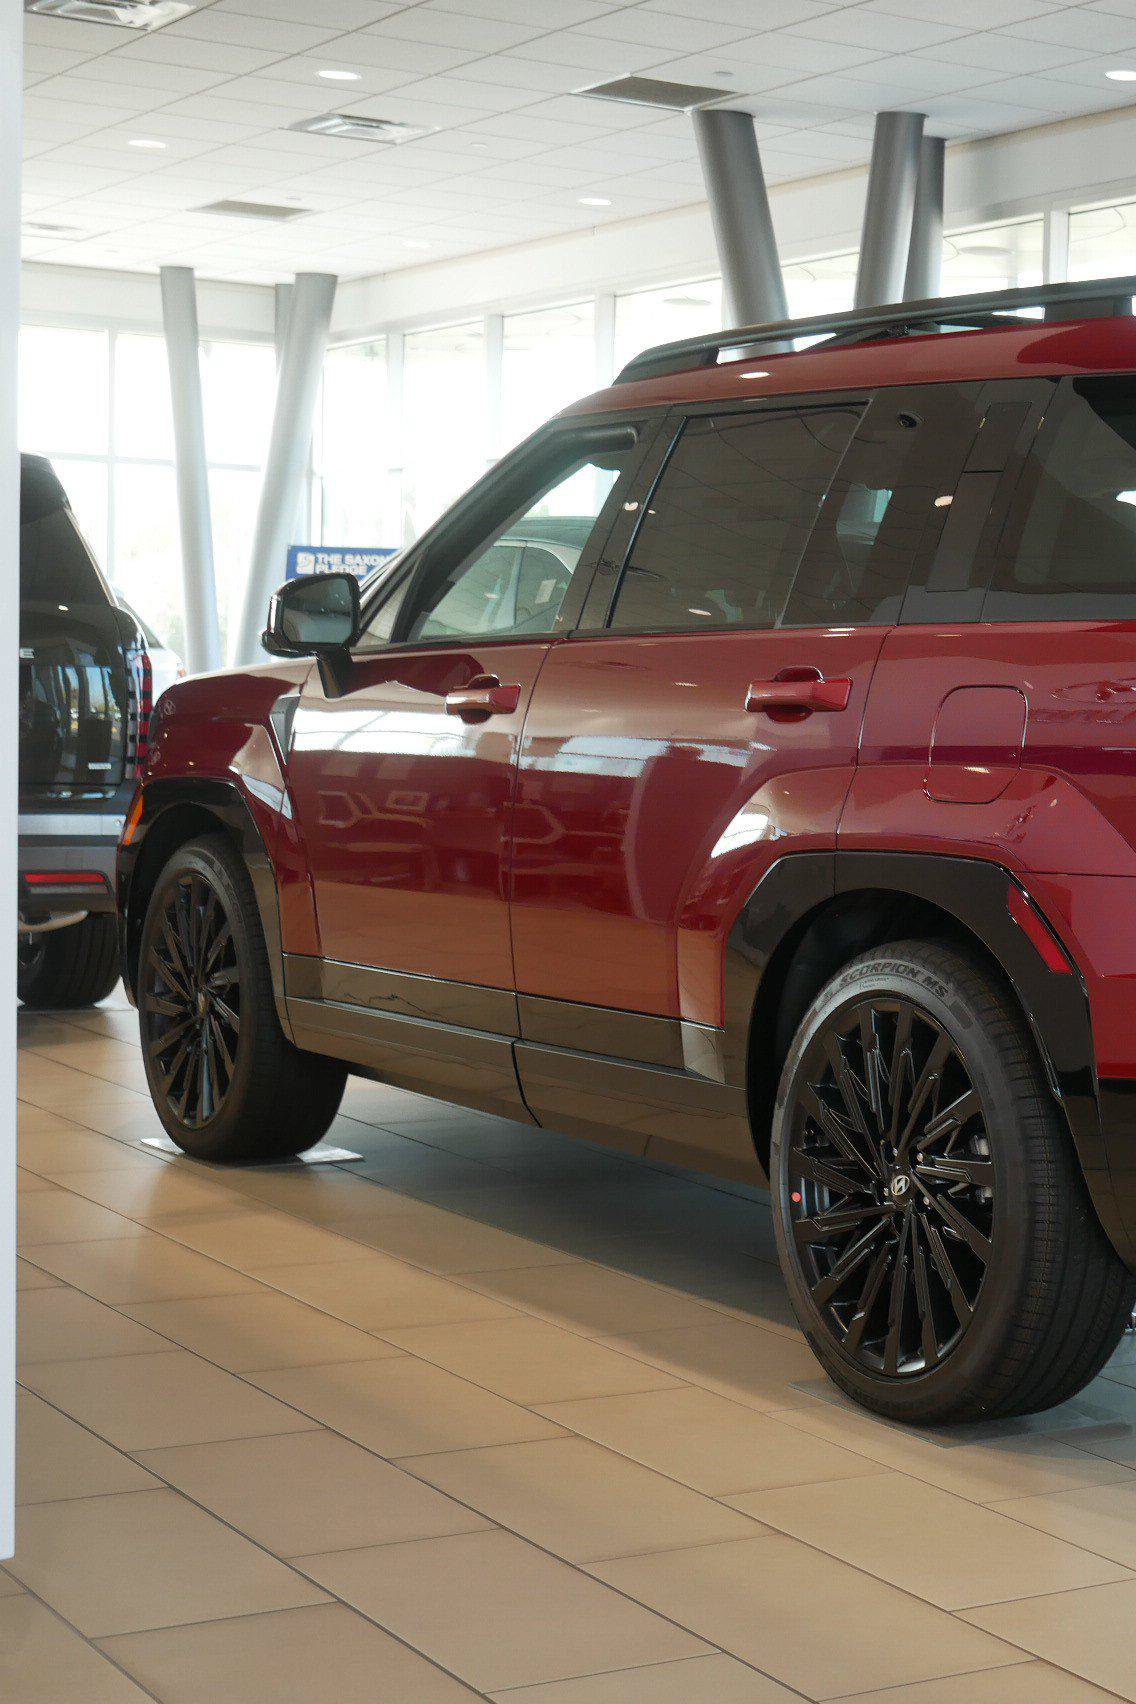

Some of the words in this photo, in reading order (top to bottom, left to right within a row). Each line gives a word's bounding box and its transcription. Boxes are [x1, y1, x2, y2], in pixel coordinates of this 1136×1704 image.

[315, 552, 343, 566] THE
[839, 961, 920, 987] SCORPION
[922, 975, 949, 998] MS
